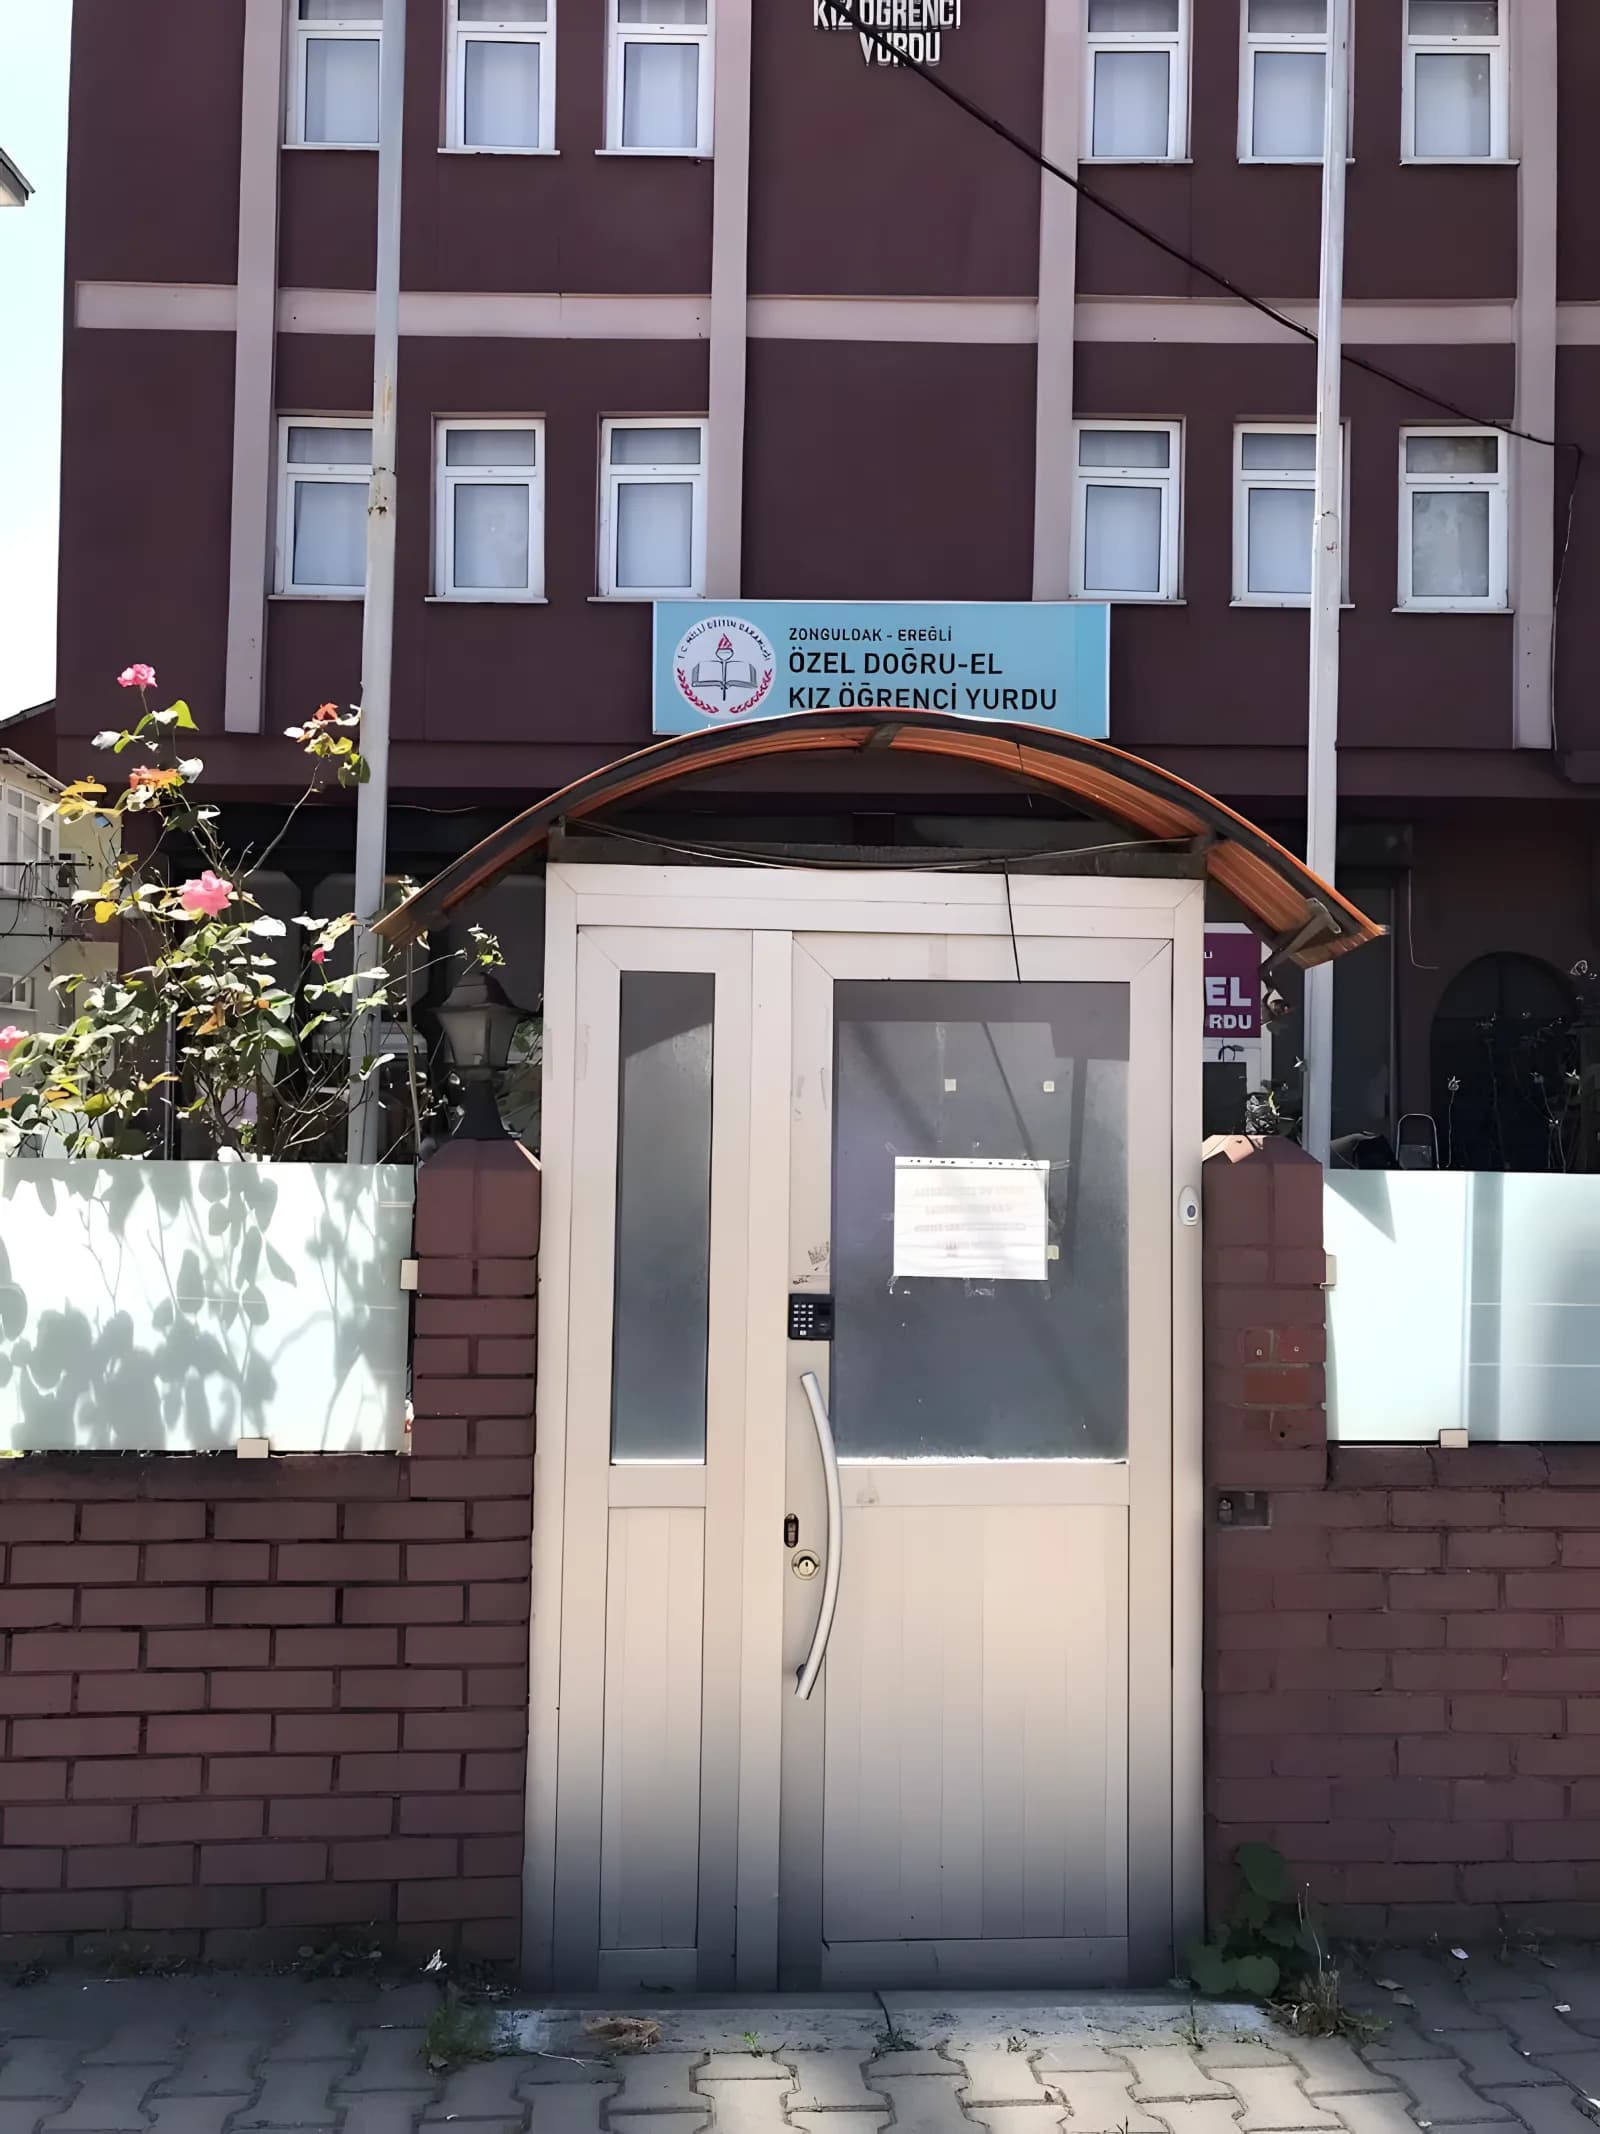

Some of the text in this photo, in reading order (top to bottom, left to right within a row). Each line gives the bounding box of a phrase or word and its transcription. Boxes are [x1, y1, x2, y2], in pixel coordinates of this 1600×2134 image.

[789, 627, 882, 641] ZONGULDAK
[898, 625, 952, 642] EREĞLİ
[789, 646, 1003, 675] ÖZEL DOĞRU-EL
[789, 682, 1057, 710] KIZ ÖĞRENCİ YURDU
[1205, 976, 1252, 1007] EL
[1209, 1014, 1252, 1030] RDU
